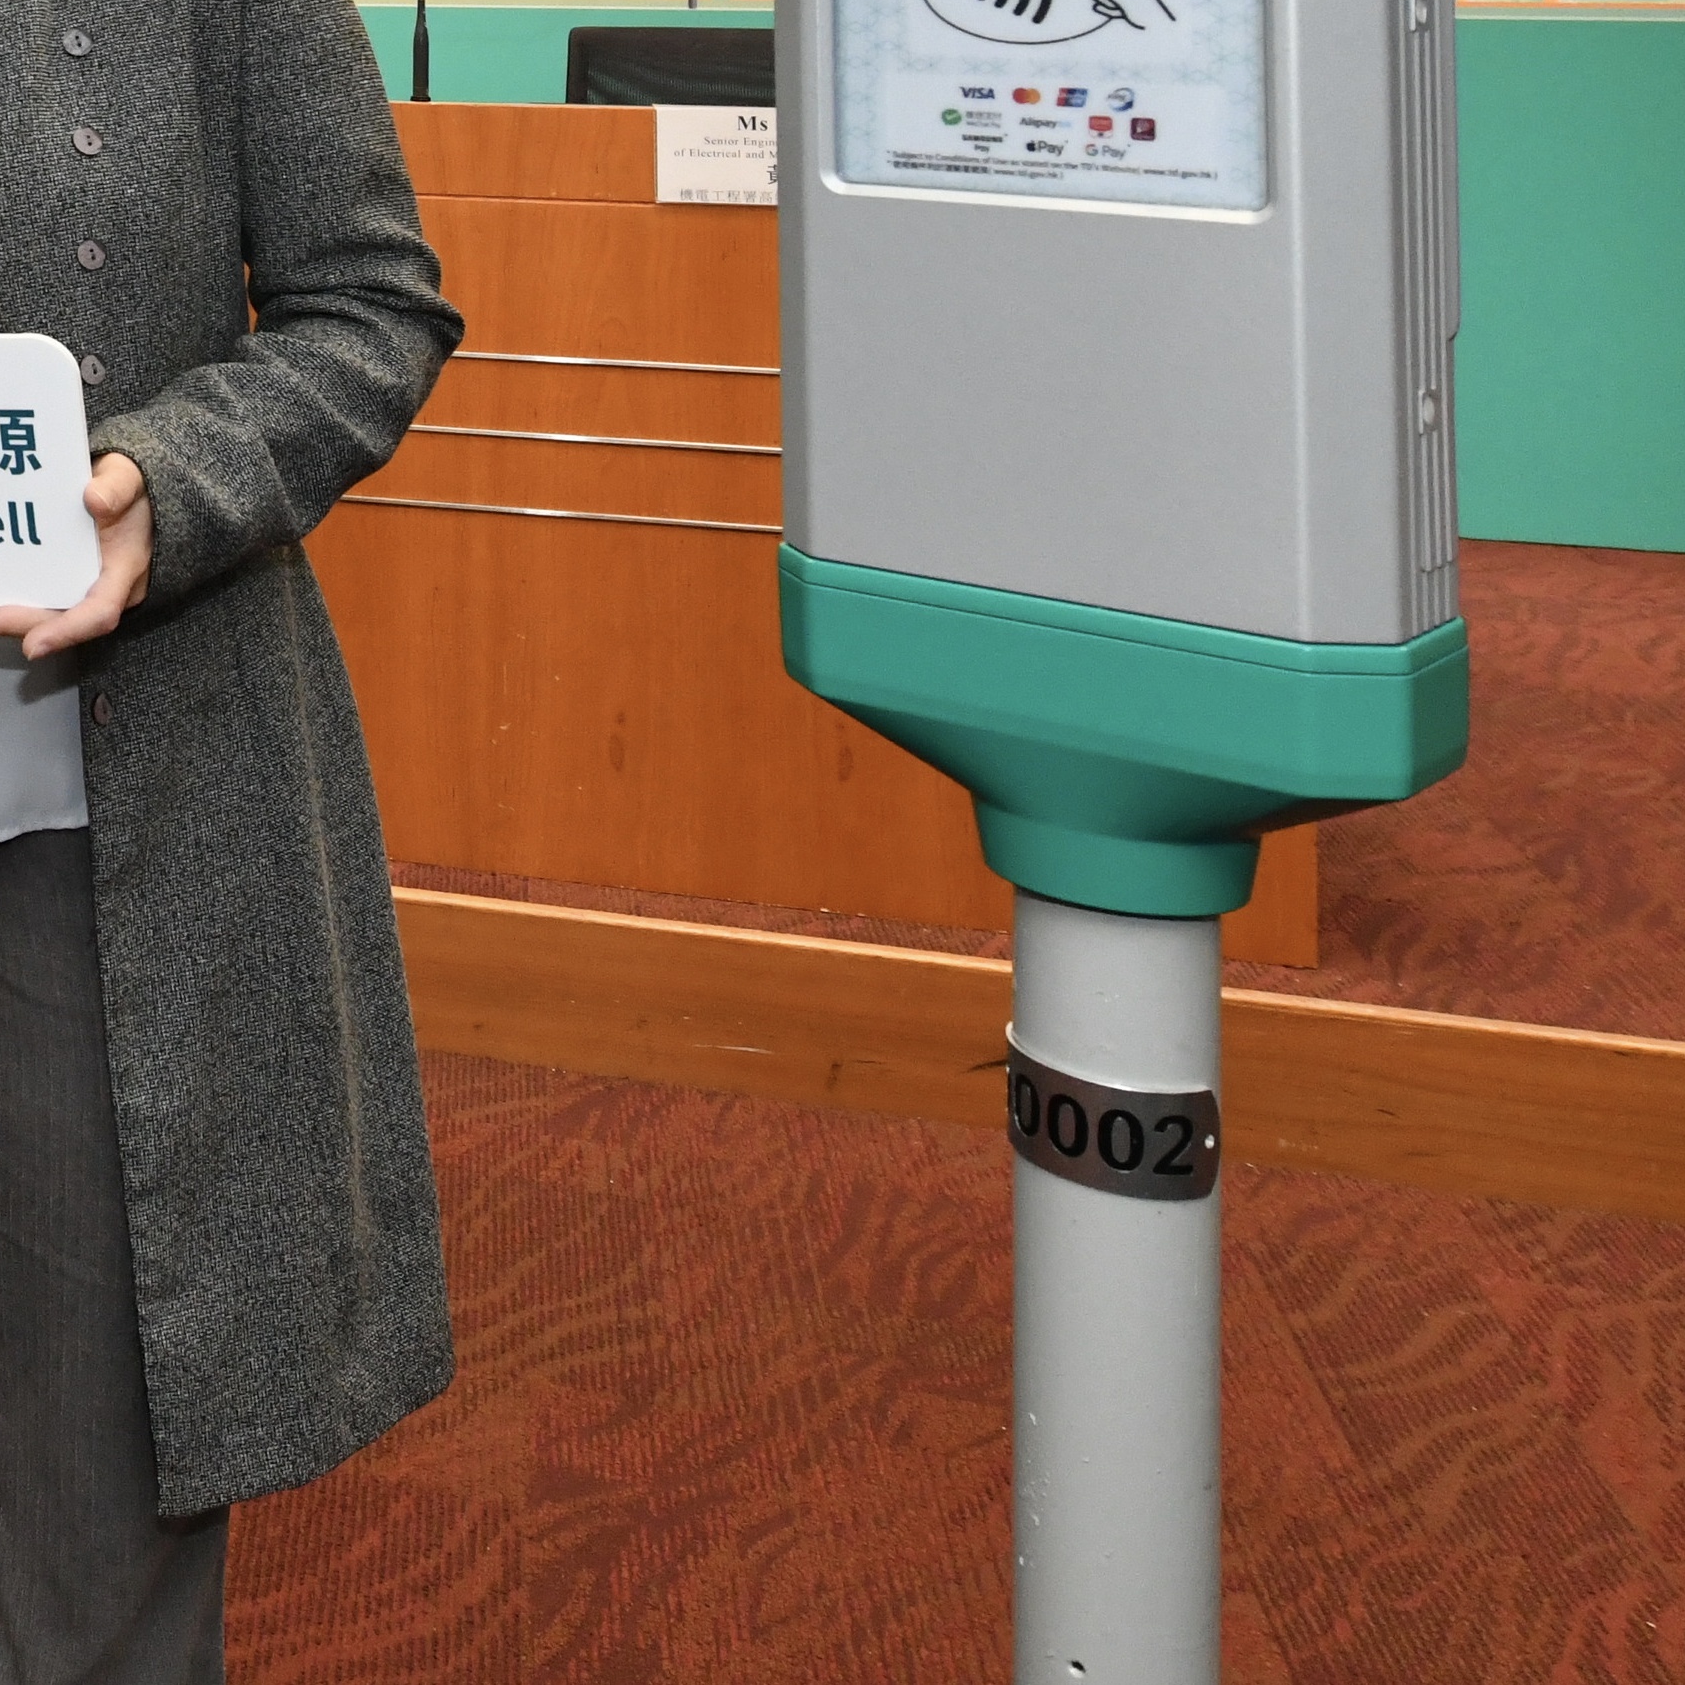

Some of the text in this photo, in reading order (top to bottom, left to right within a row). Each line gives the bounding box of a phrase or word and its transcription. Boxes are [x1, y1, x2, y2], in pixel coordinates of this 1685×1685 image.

[960, 86, 995, 100] VISA
[738, 115, 768, 131] Ms
[704, 137, 738, 146] Senior
[1038, 141, 1064, 155] Pay
[674, 149, 686, 157] of
[690, 149, 741, 158] Electrical
[746, 150, 764, 159] and
[1102, 145, 1126, 160] Pay
